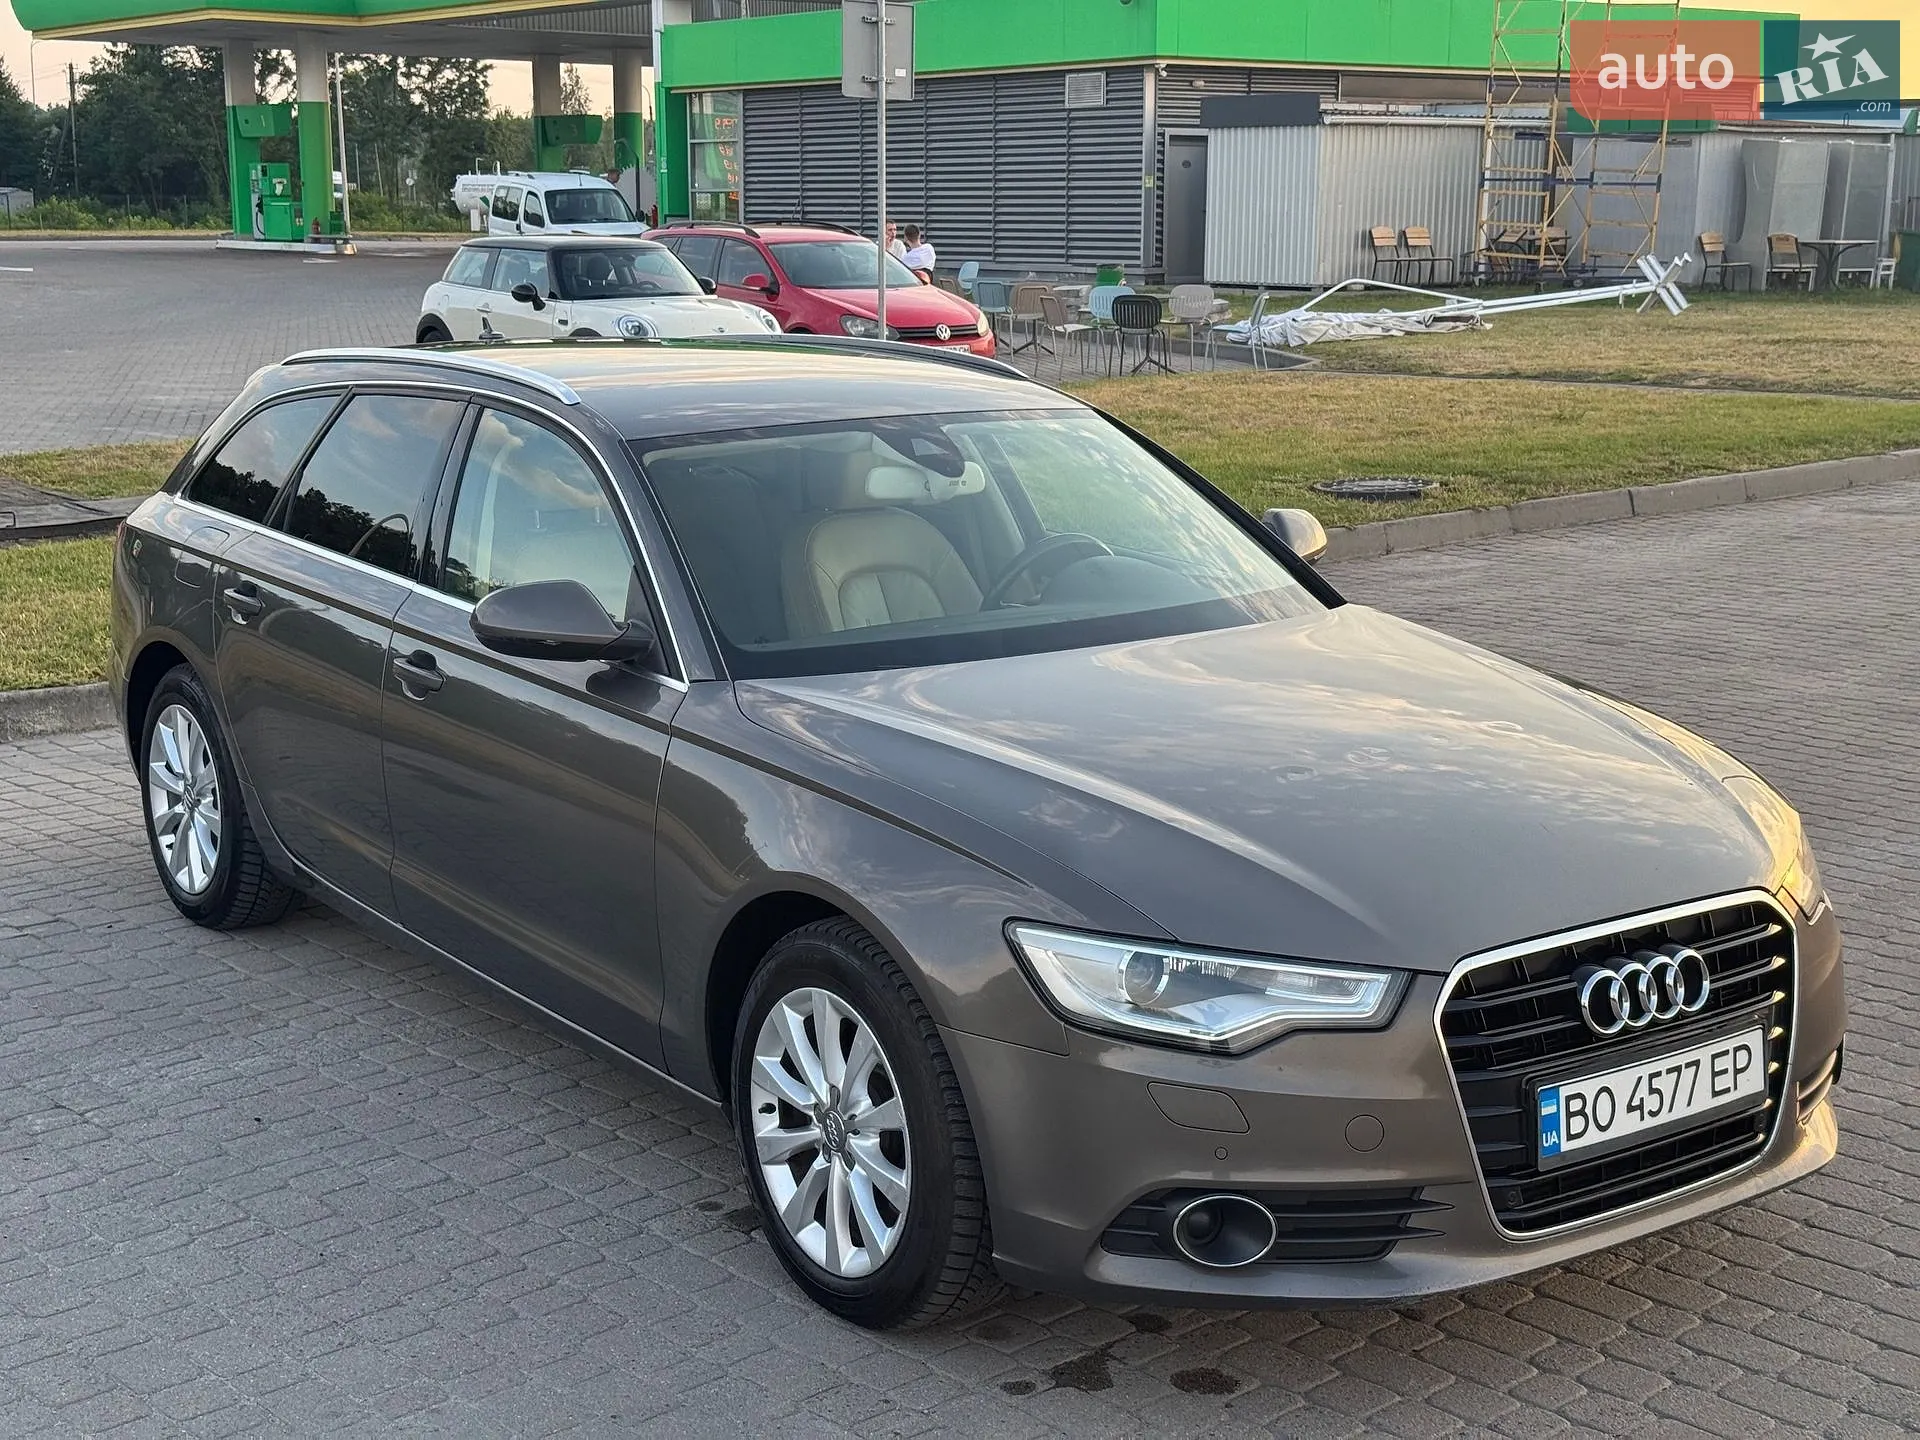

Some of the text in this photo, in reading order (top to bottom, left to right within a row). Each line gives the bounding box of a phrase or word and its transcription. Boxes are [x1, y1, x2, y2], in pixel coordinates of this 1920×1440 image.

[1564, 1042, 1752, 1142] BO 4577 EP
[1542, 1130, 1559, 1147] UA
